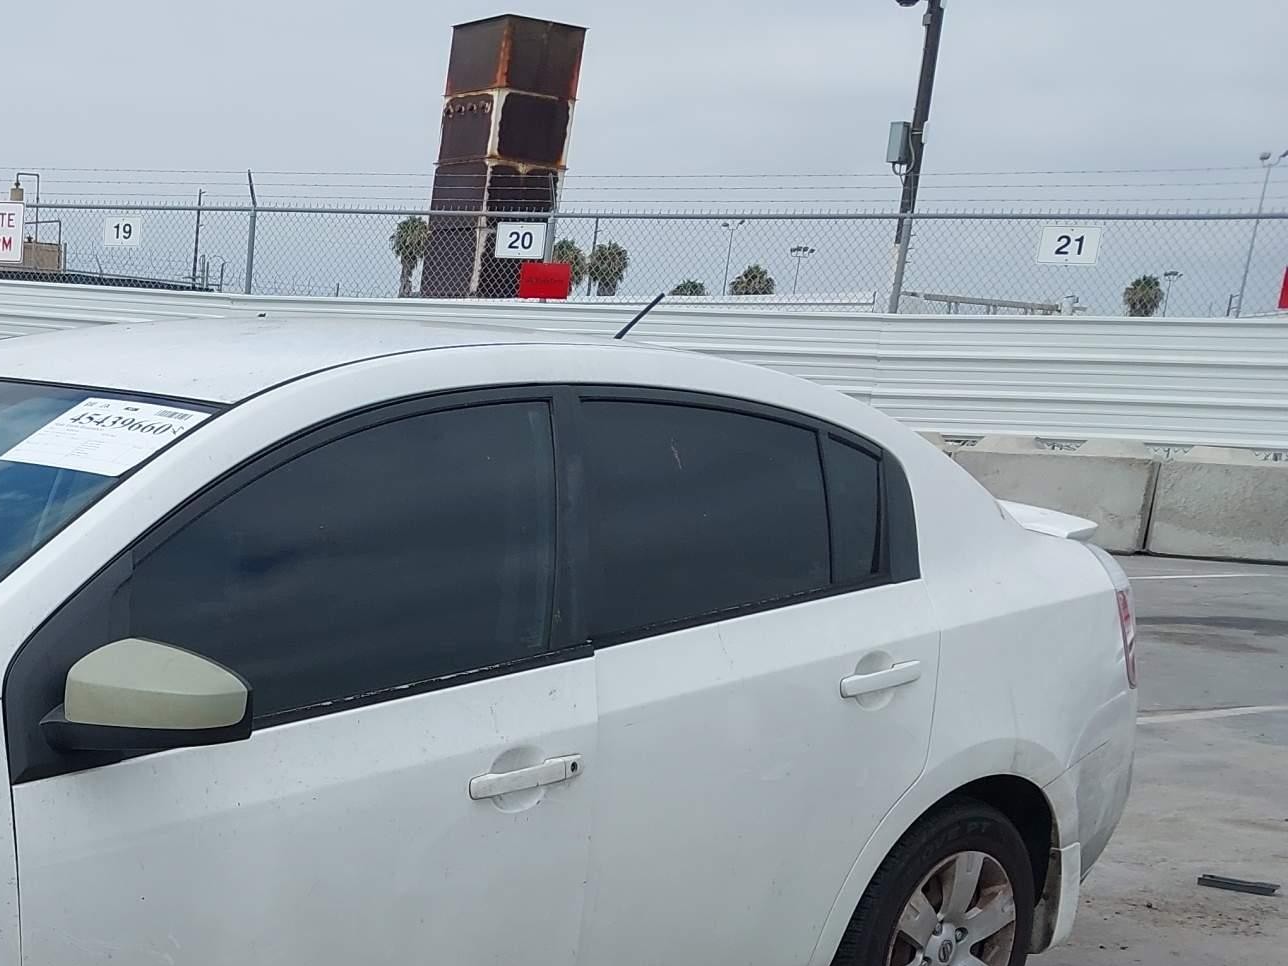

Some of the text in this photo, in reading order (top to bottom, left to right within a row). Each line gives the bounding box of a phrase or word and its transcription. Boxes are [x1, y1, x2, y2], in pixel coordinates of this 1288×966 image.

[113, 223, 132, 240] 19
[507, 231, 533, 250] 20
[1054, 234, 1085, 256] 21
[70, 411, 173, 436] 45439660
